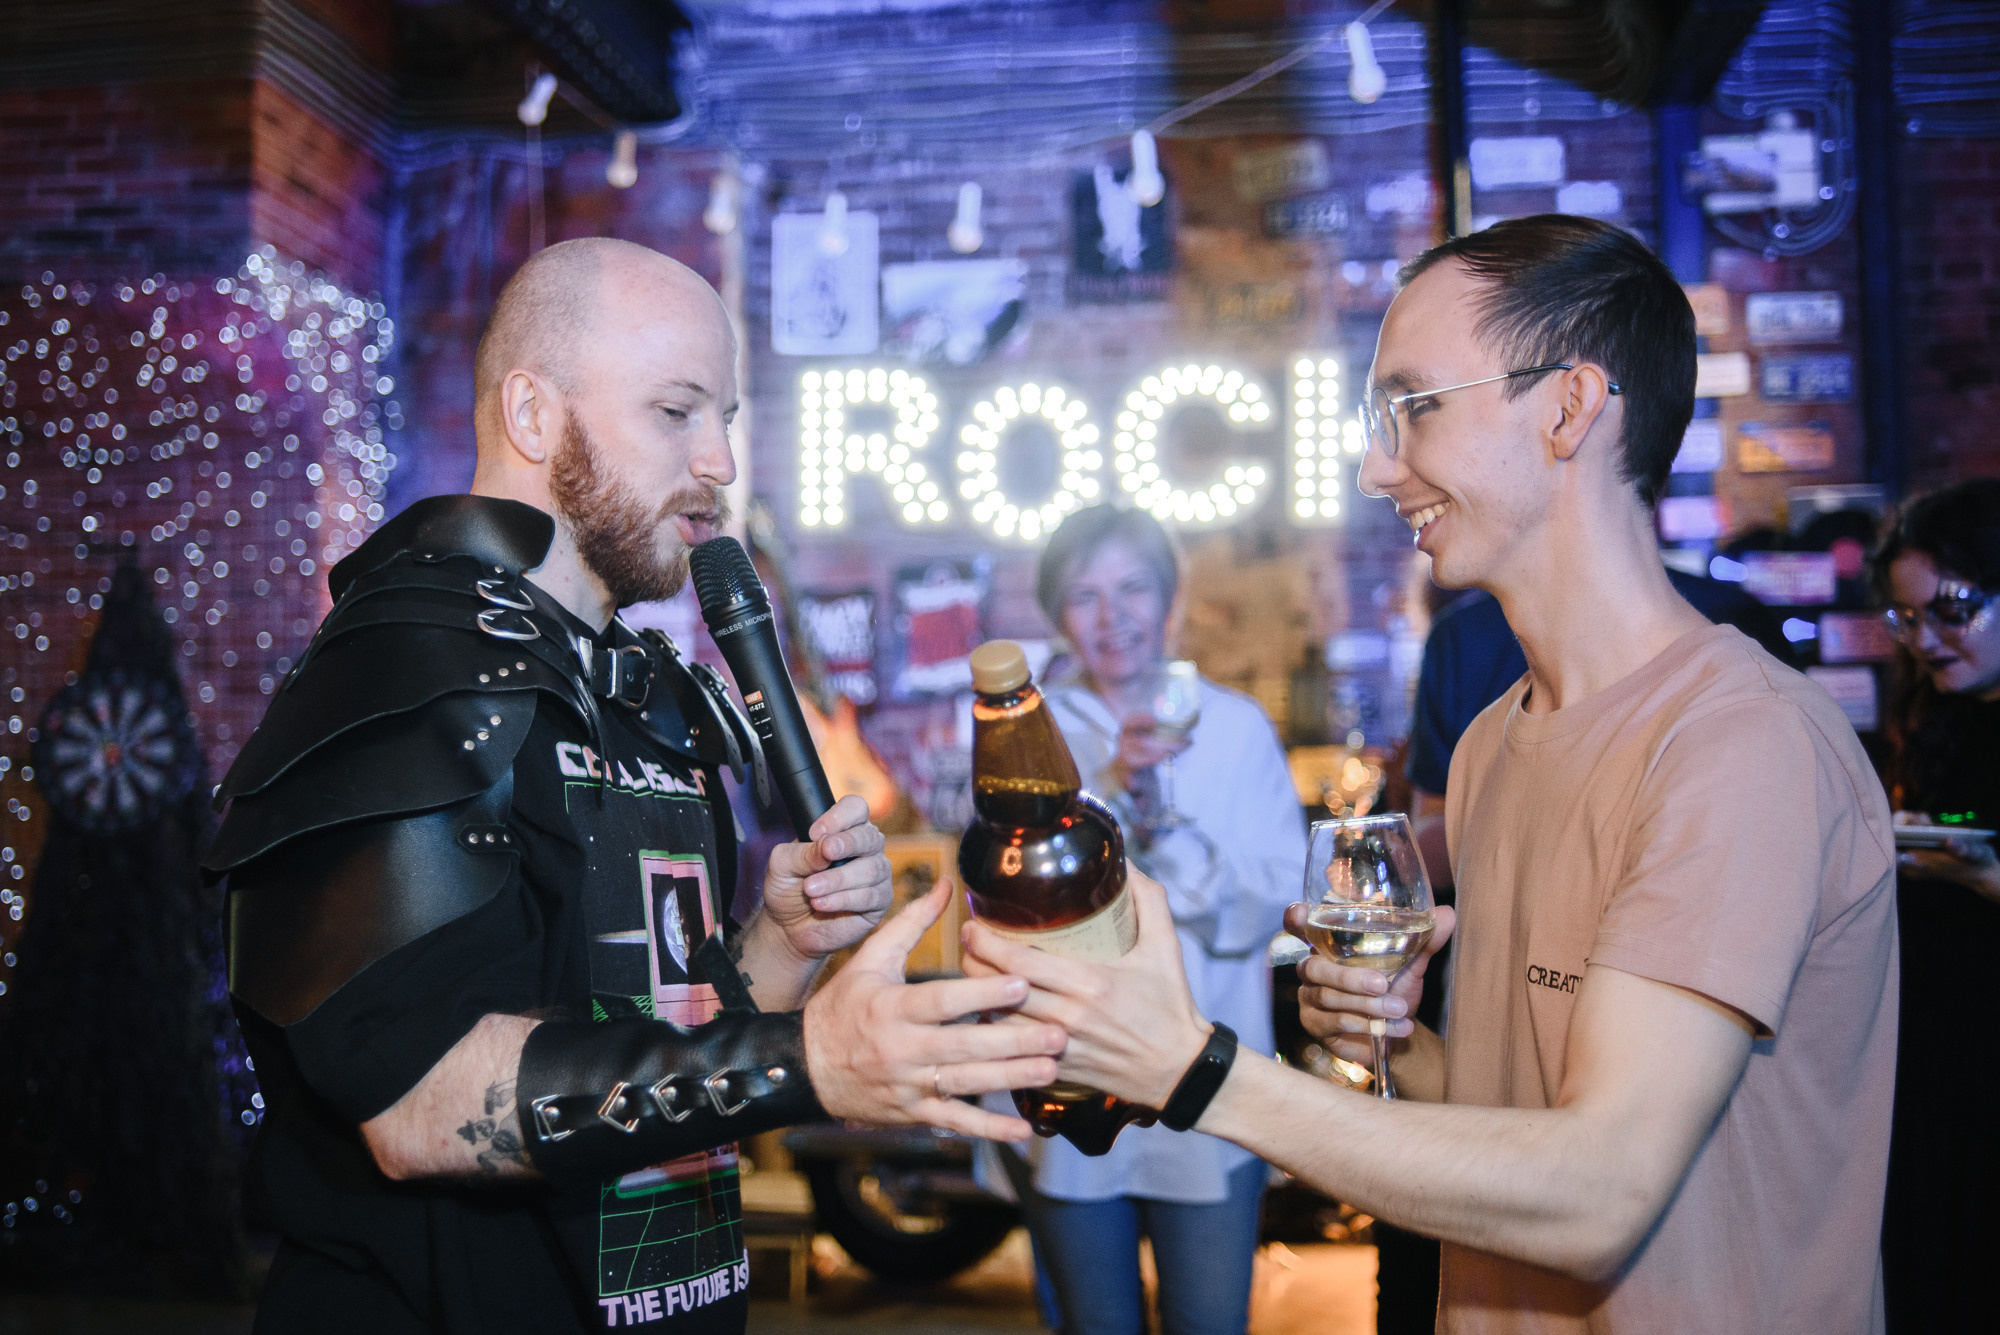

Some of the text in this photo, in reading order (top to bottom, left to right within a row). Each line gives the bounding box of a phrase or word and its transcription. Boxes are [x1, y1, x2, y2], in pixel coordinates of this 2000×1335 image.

[1527, 964, 1583, 994] CREAT
[598, 1289, 663, 1327] THE
[664, 1268, 731, 1316] FUTURE
